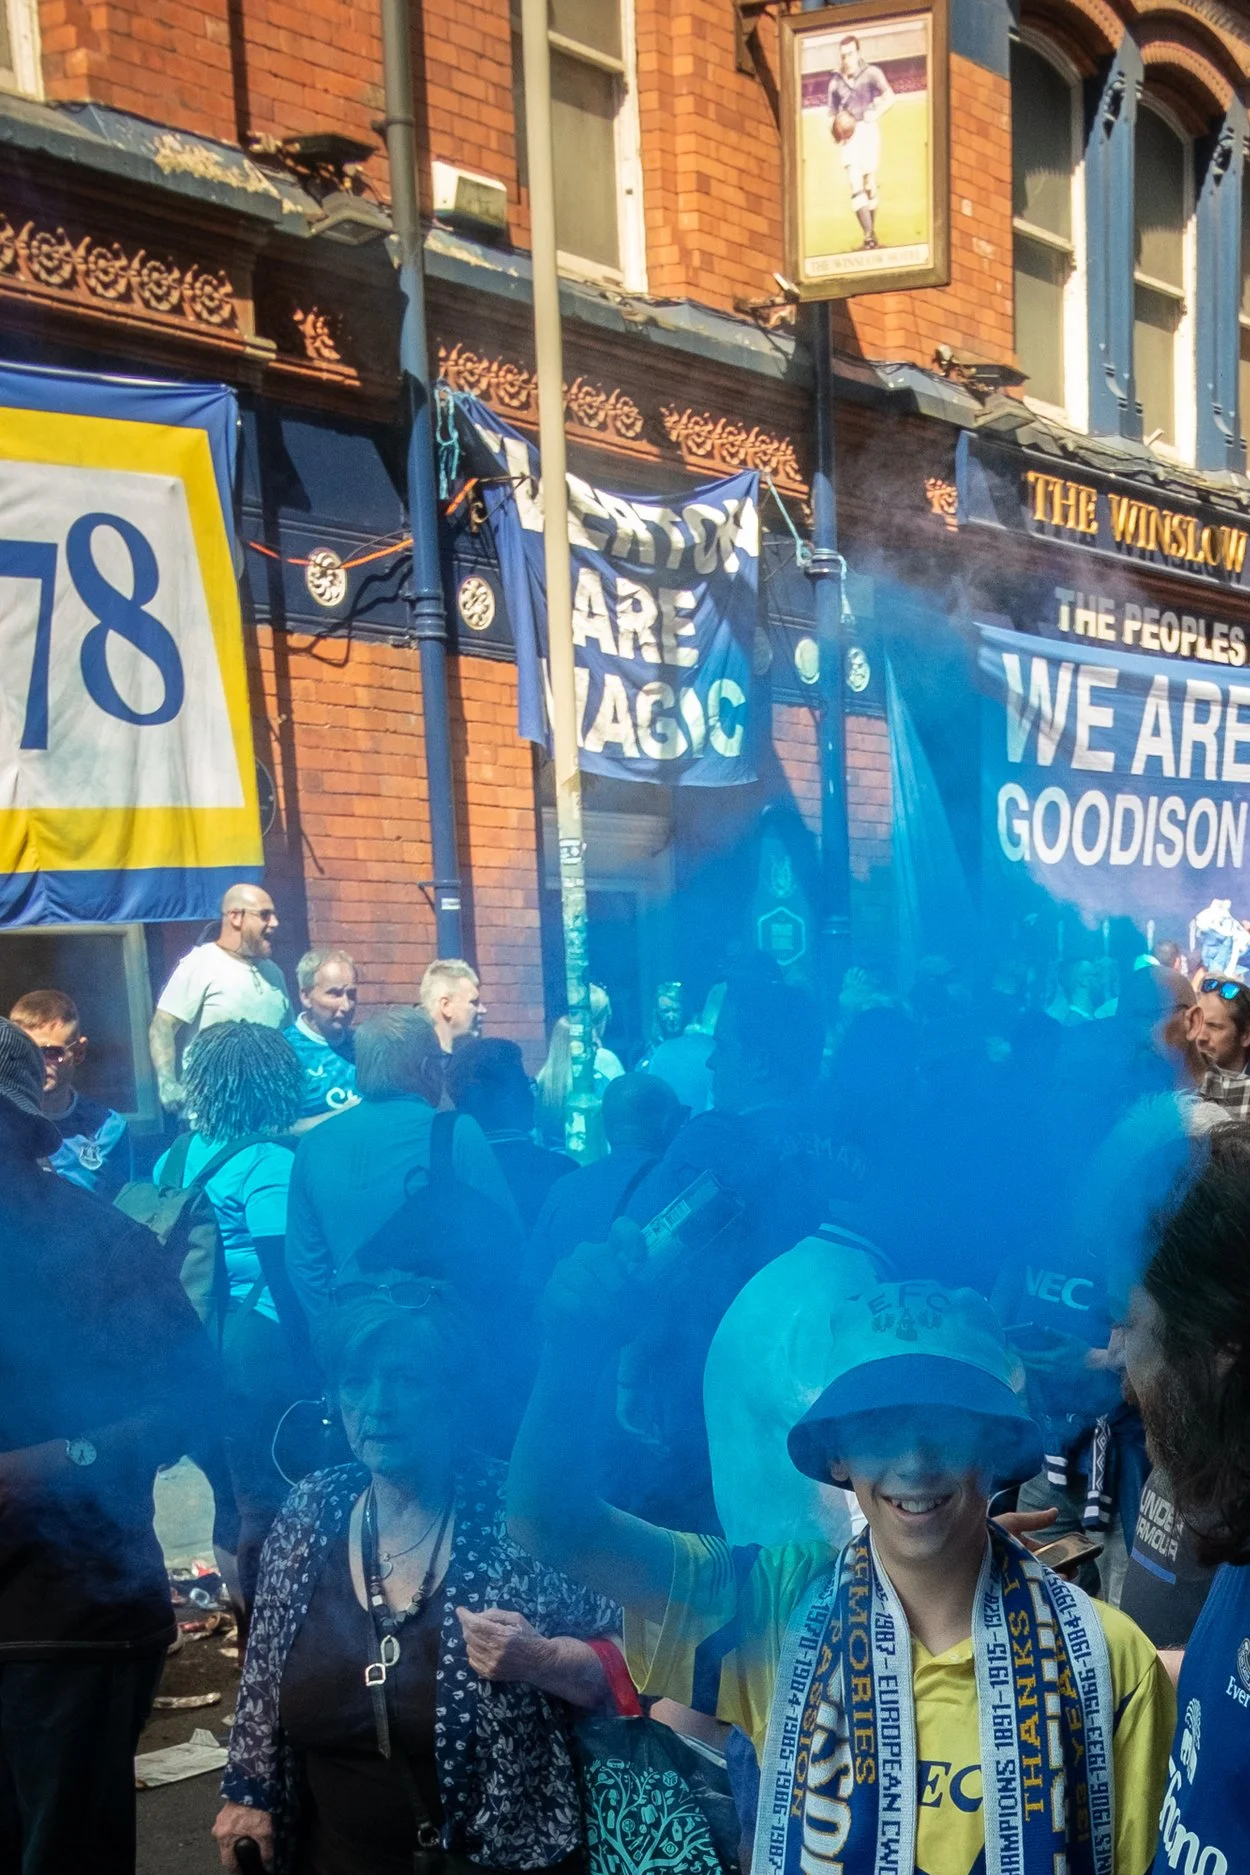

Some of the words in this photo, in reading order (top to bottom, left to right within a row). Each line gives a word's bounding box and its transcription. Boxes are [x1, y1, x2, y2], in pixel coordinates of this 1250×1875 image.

[1027, 470, 1098, 535] THE
[1108, 492, 1248, 575] WINSLOW
[572, 567, 699, 667] ARE
[1055, 589, 1117, 643] THE
[1123, 604, 1247, 668] PEOPLES
[1002, 652, 1117, 774] WE
[997, 782, 1249, 869] GOODISON
[867, 1283, 951, 1315] EFC
[878, 1675, 903, 1812] EUROPEAN
[1009, 1610, 1044, 1822] THANKS
[917, 1759, 984, 1813] EC
